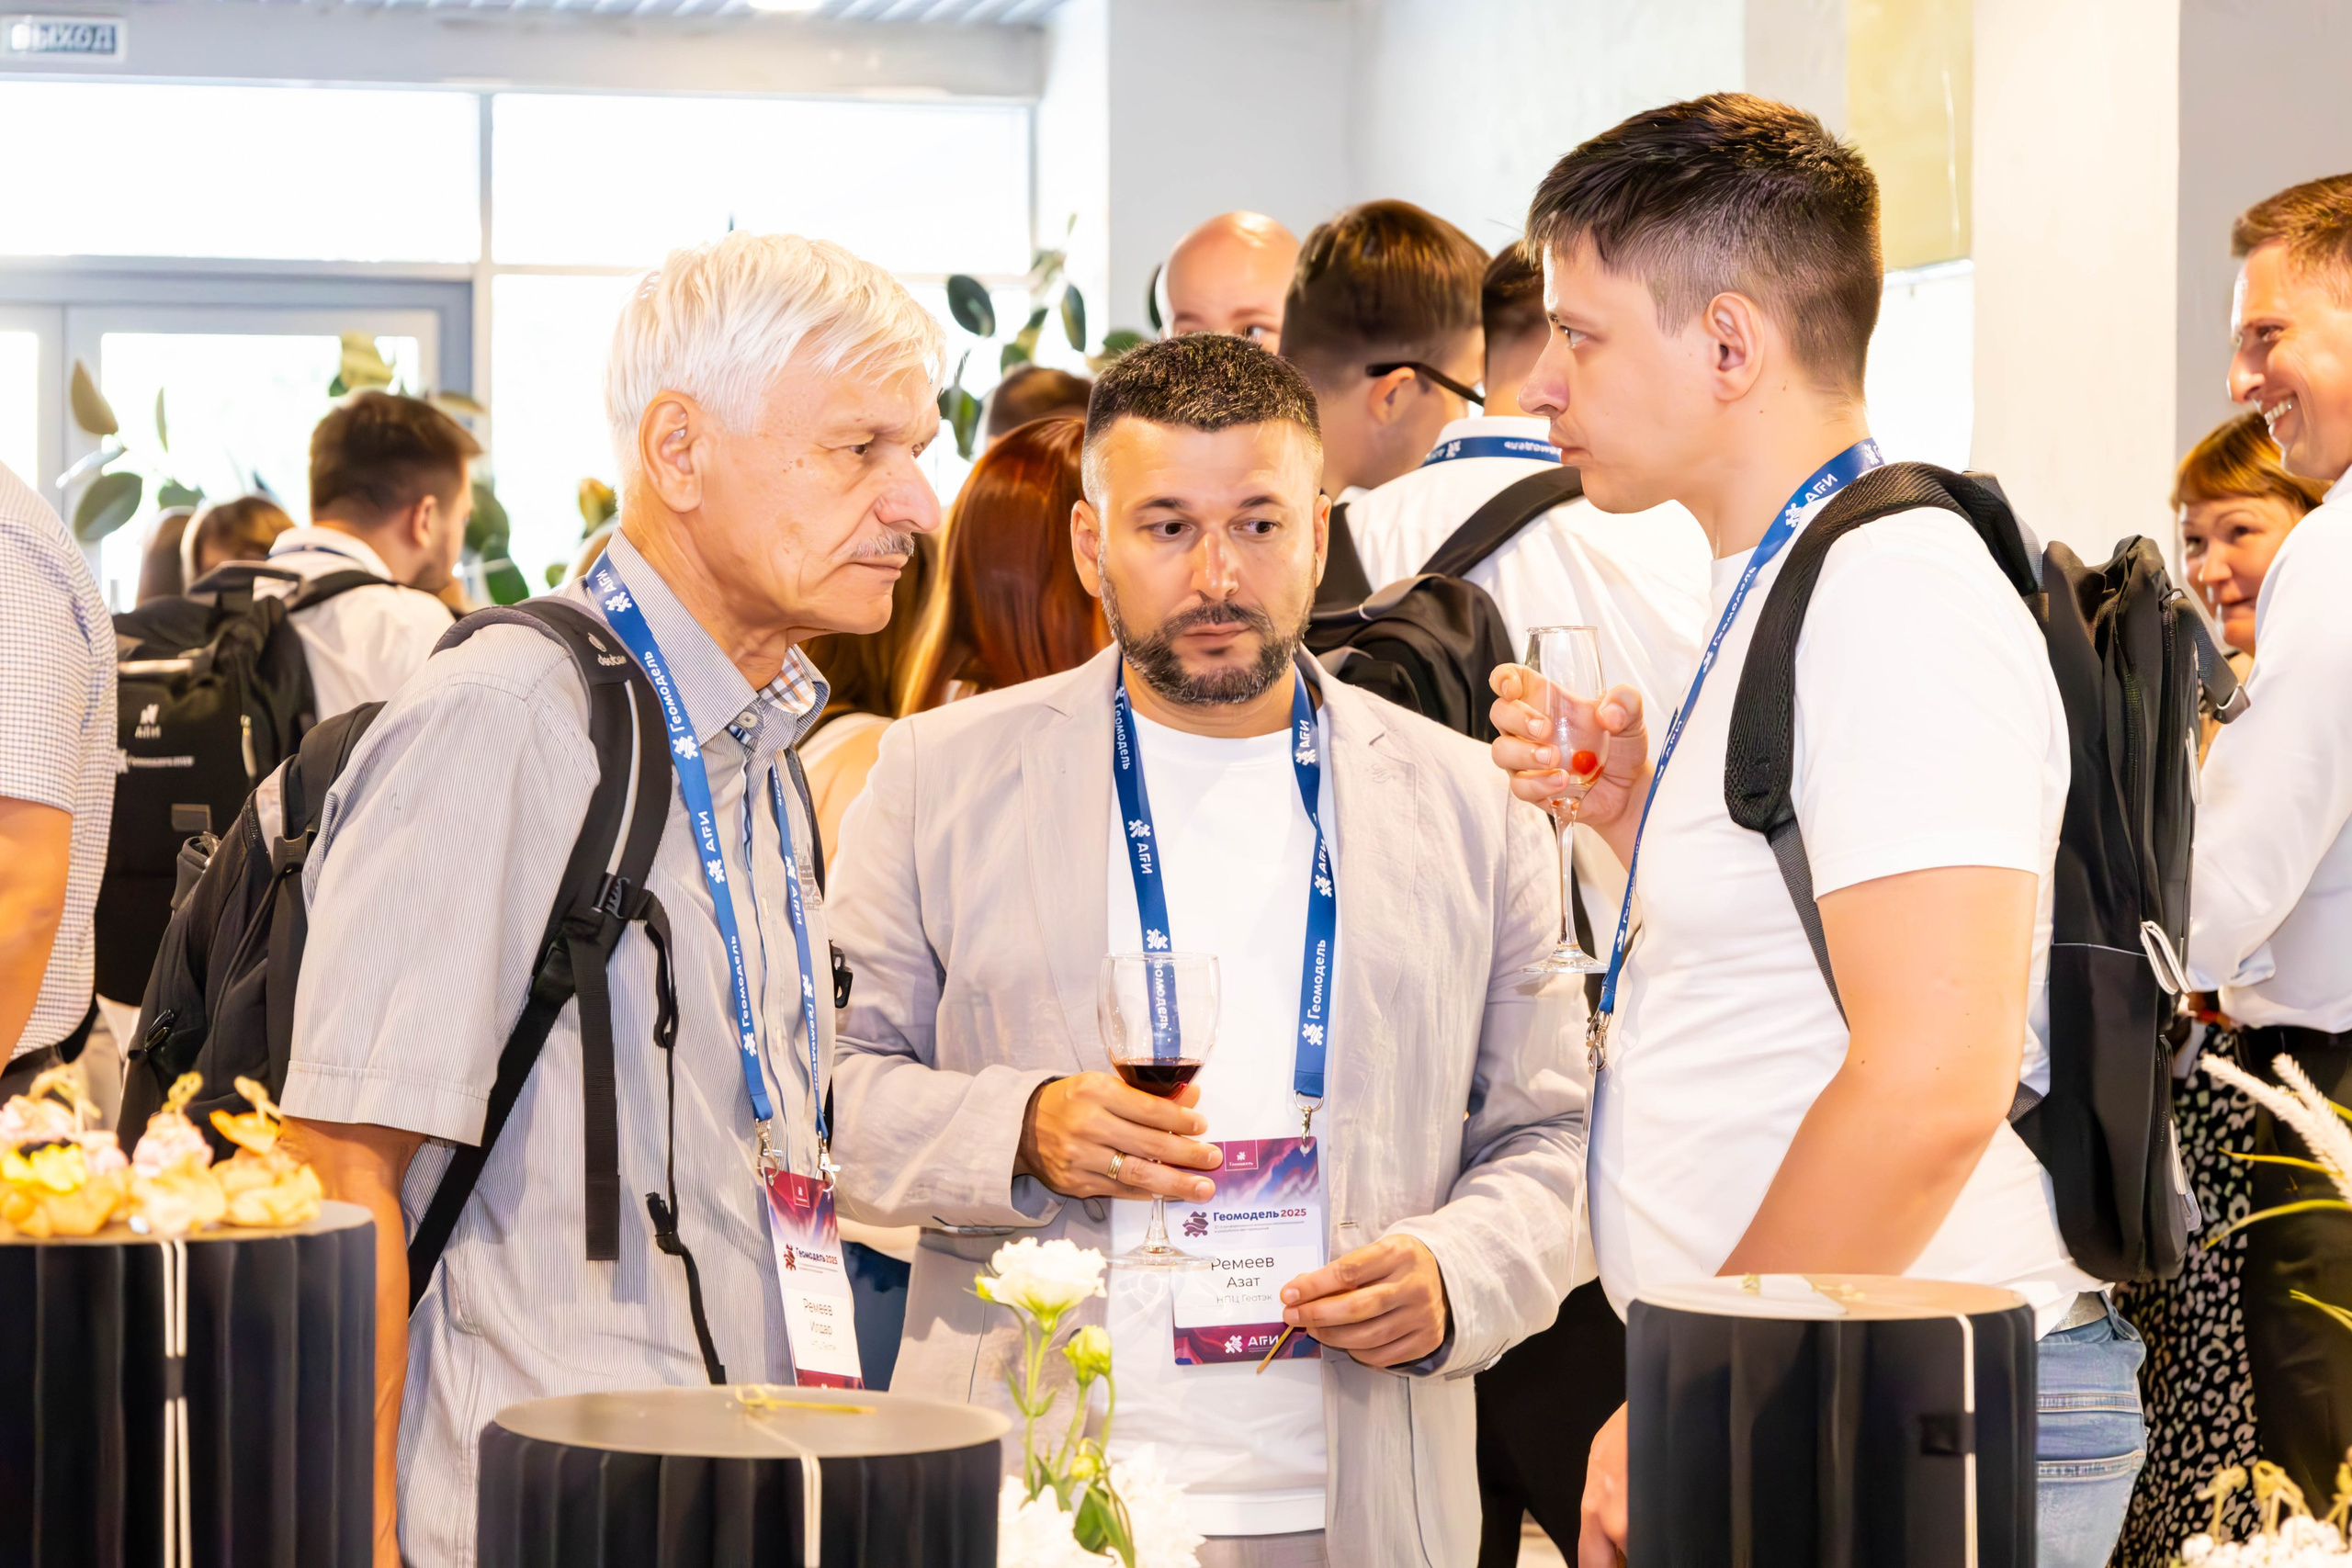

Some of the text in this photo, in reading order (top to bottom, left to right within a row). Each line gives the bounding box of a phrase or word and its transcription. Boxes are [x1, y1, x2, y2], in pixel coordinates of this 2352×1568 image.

[644, 651, 685, 733] Геомодель
[1114, 703, 1131, 771] Геомодель
[731, 935, 751, 1027] Геомодель
[1154, 958, 1169, 1031] еомодель
[1307, 939, 1326, 1020] Геомодель
[1213, 1208, 1306, 1222] Геомодель 2025
[1211, 1257, 1274, 1271] Ремеев
[1227, 1277, 1261, 1288] Азат
